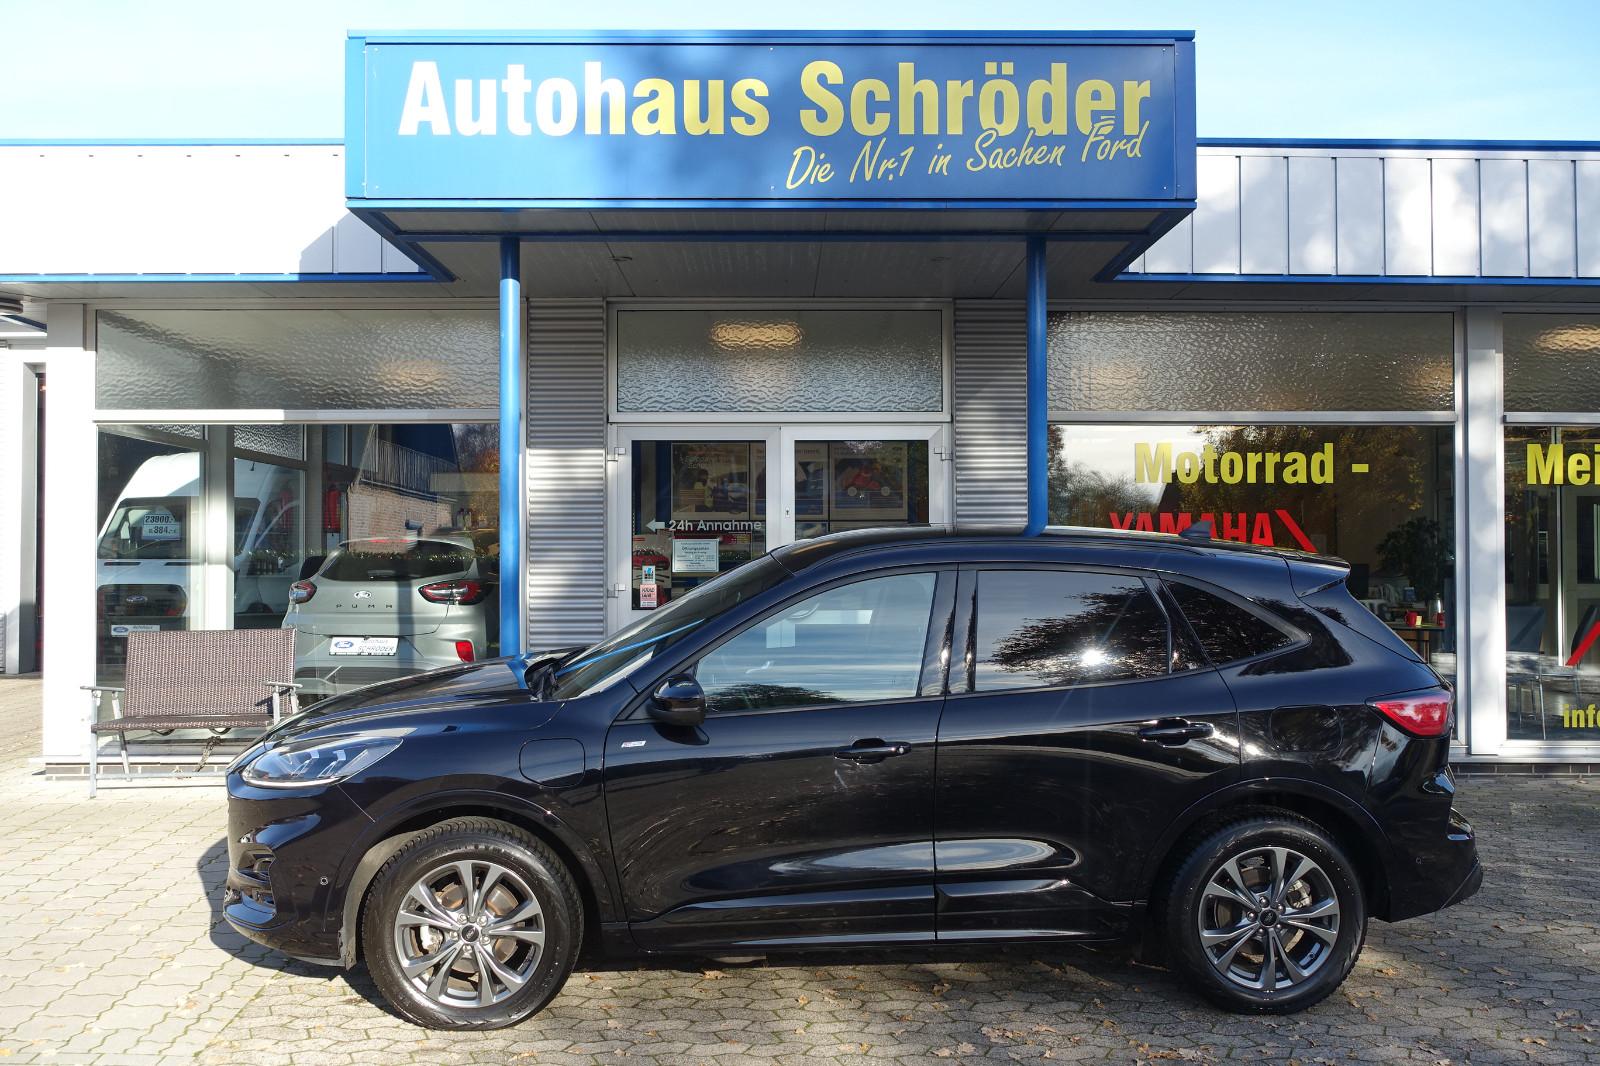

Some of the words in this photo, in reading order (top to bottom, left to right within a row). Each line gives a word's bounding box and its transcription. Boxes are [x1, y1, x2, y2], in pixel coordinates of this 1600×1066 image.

[398, 61, 770, 136] Autohaus
[800, 60, 1151, 136] Schröder
[786, 145, 834, 190] Die
[849, 137, 915, 183] Nr.1
[928, 144, 952, 176] in
[966, 129, 1066, 172] Sachen
[1081, 115, 1150, 163] Ford
[1135, 442, 1334, 484] Motorrad
[669, 519, 693, 531] 24h
[697, 519, 762, 531] Annahme
